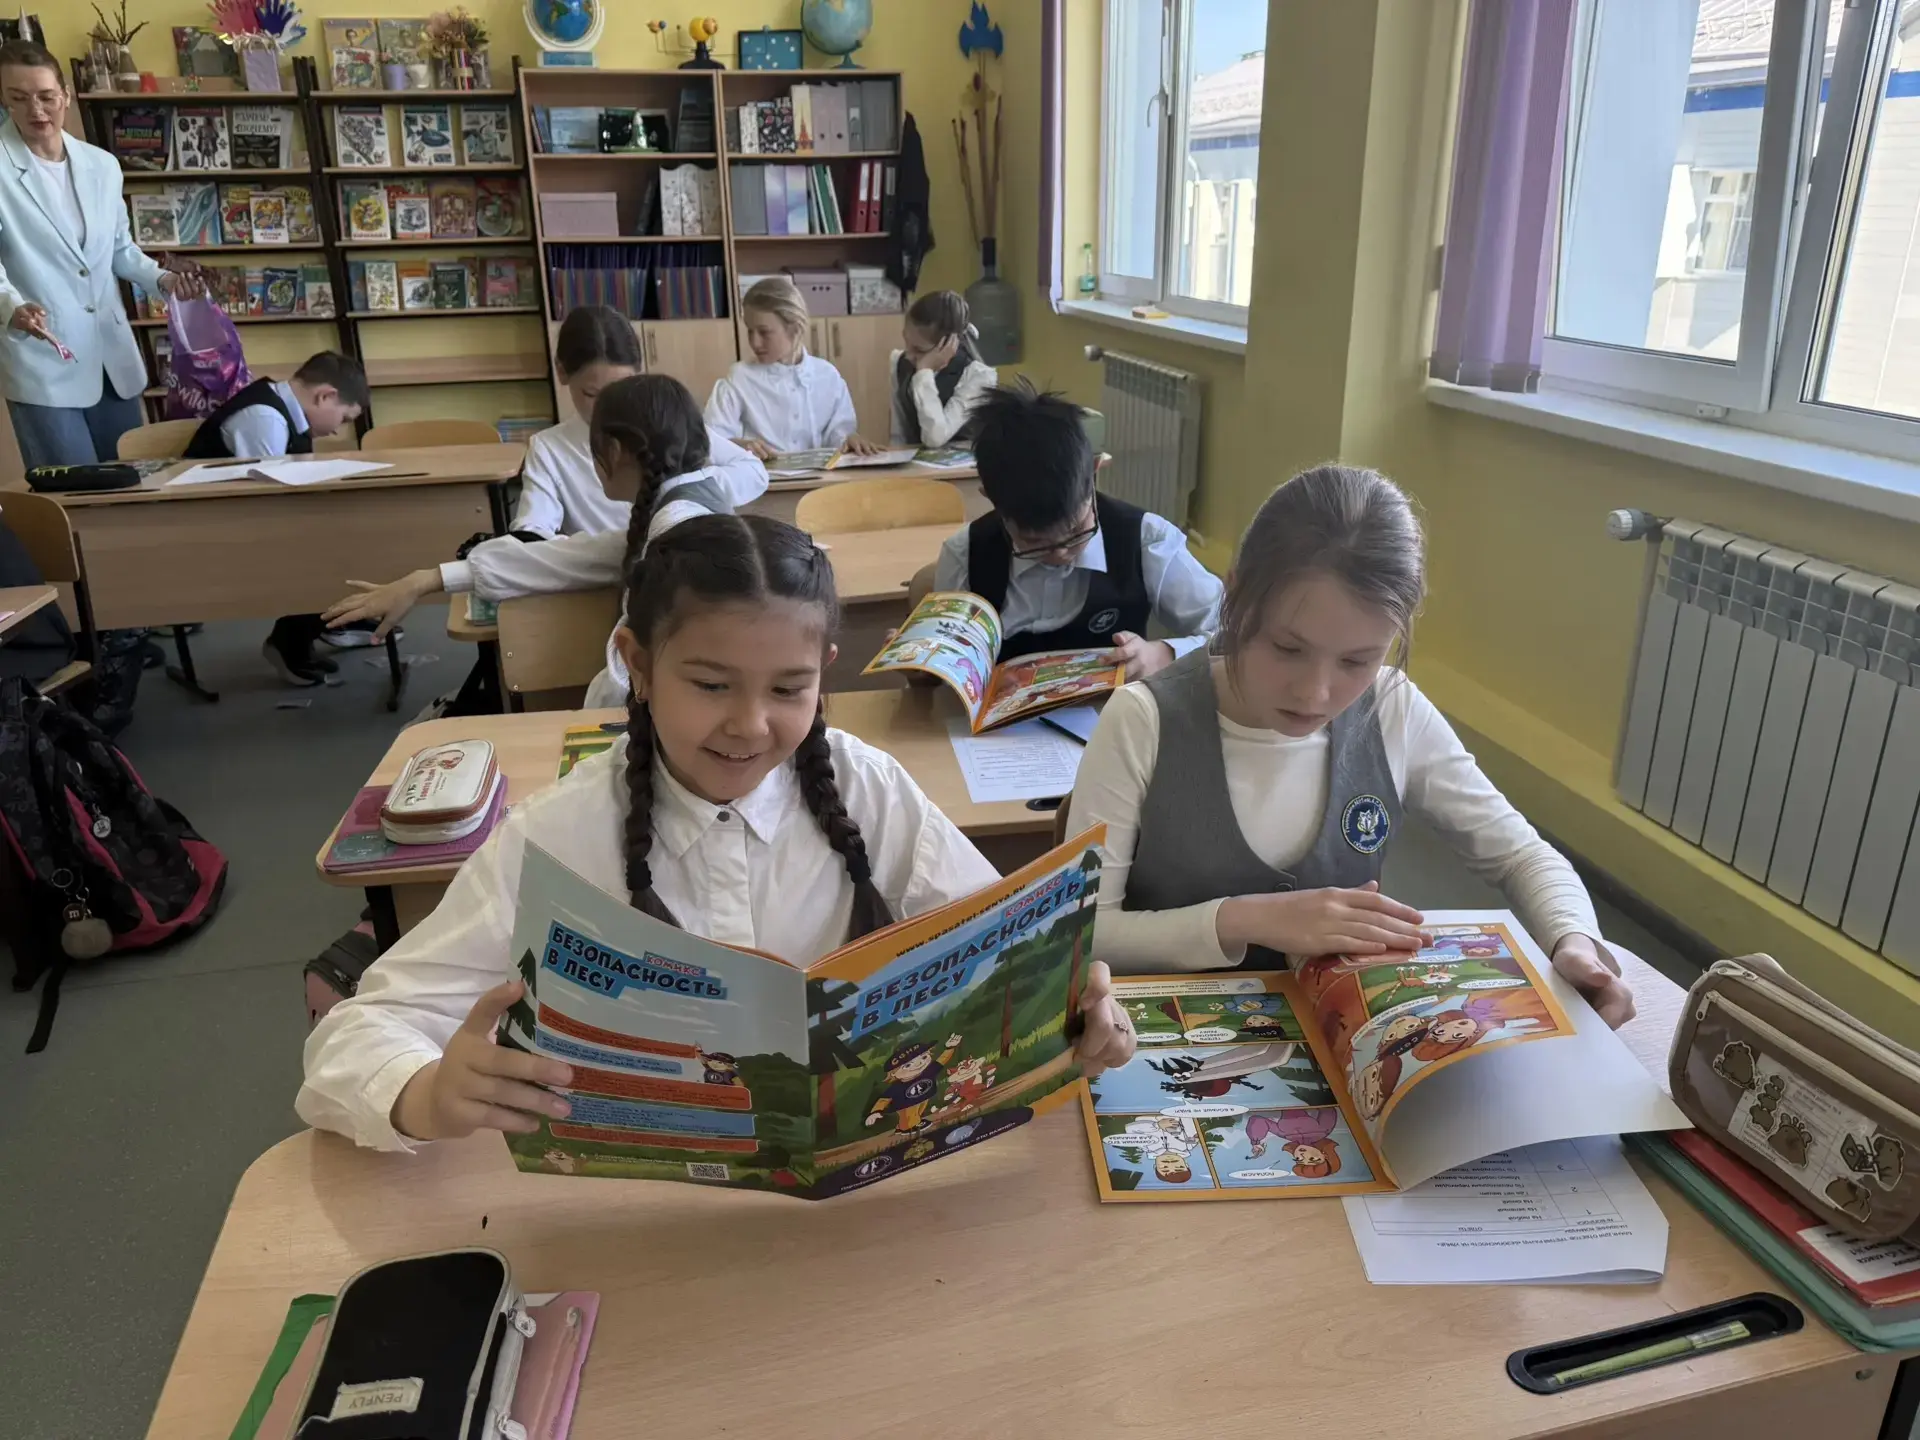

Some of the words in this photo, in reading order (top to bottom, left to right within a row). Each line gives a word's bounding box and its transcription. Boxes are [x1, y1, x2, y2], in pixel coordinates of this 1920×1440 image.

[1004, 875, 1063, 918] КОМИКС
[552, 926, 722, 996] БЕЗОПАСНОСТЬ
[865, 880, 1080, 1008] БЕЗОПАСНОСТЬ
[547, 948, 558, 965] В
[563, 958, 616, 991] ЛЕСУ
[646, 956, 701, 976] КОМИКС
[861, 1010, 880, 1029] В
[891, 967, 967, 1015] ЛЕСУ
[349, 1393, 404, 1409] PENFLY
